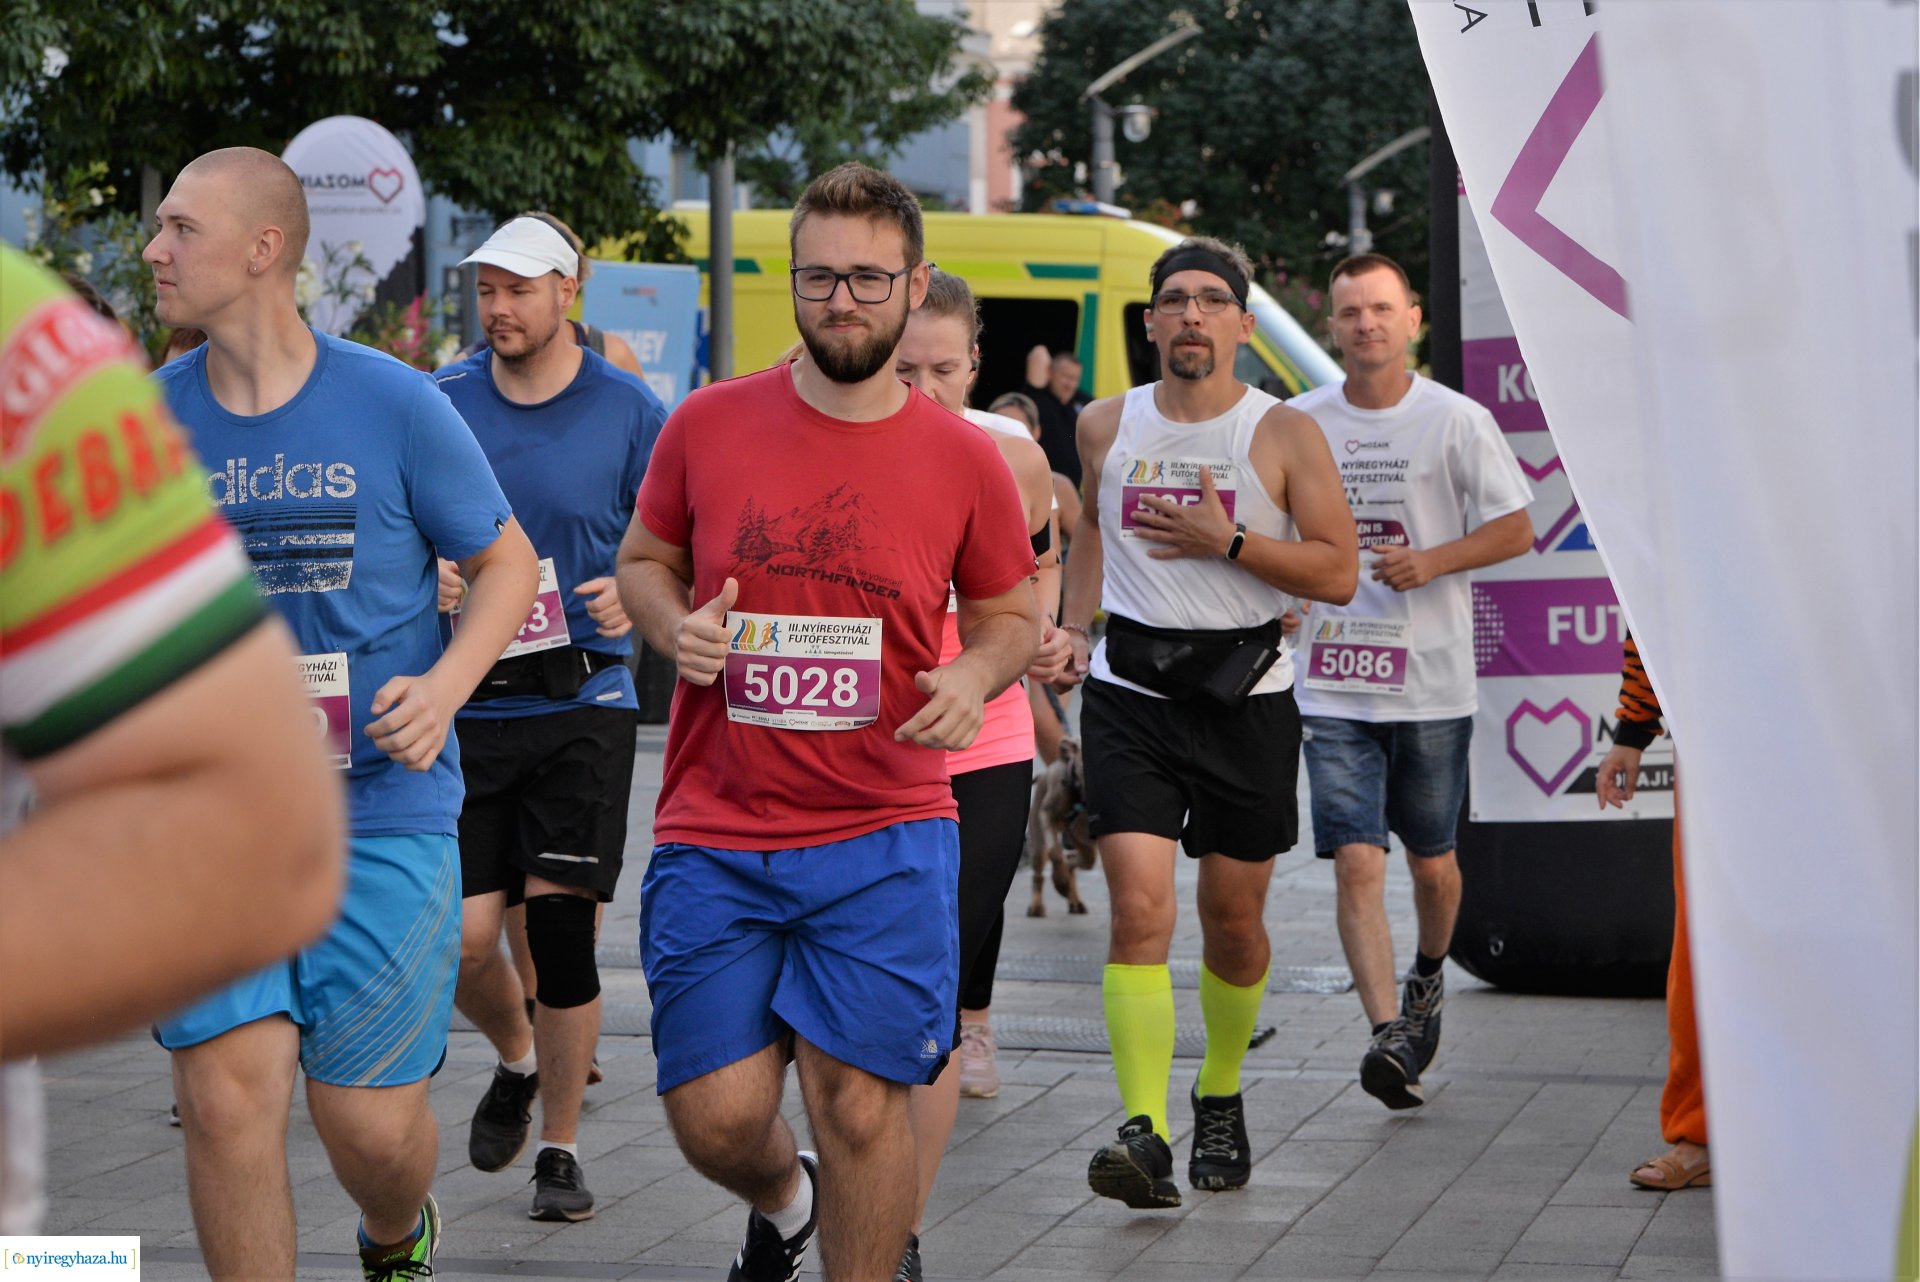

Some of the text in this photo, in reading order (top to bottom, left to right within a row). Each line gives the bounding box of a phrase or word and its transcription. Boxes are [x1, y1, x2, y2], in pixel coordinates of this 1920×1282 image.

[609, 331, 667, 363] HEY
[207, 454, 357, 507] adidas
[1171, 470, 1229, 479] FUTÓFEIVÁL
[1373, 523, 1383, 533] IS
[766, 563, 900, 600] NORTHFINDER
[788, 633, 870, 645] FUTÓFESZTIVÁL
[1320, 648, 1394, 679] 5086
[744, 663, 859, 708] 5028
